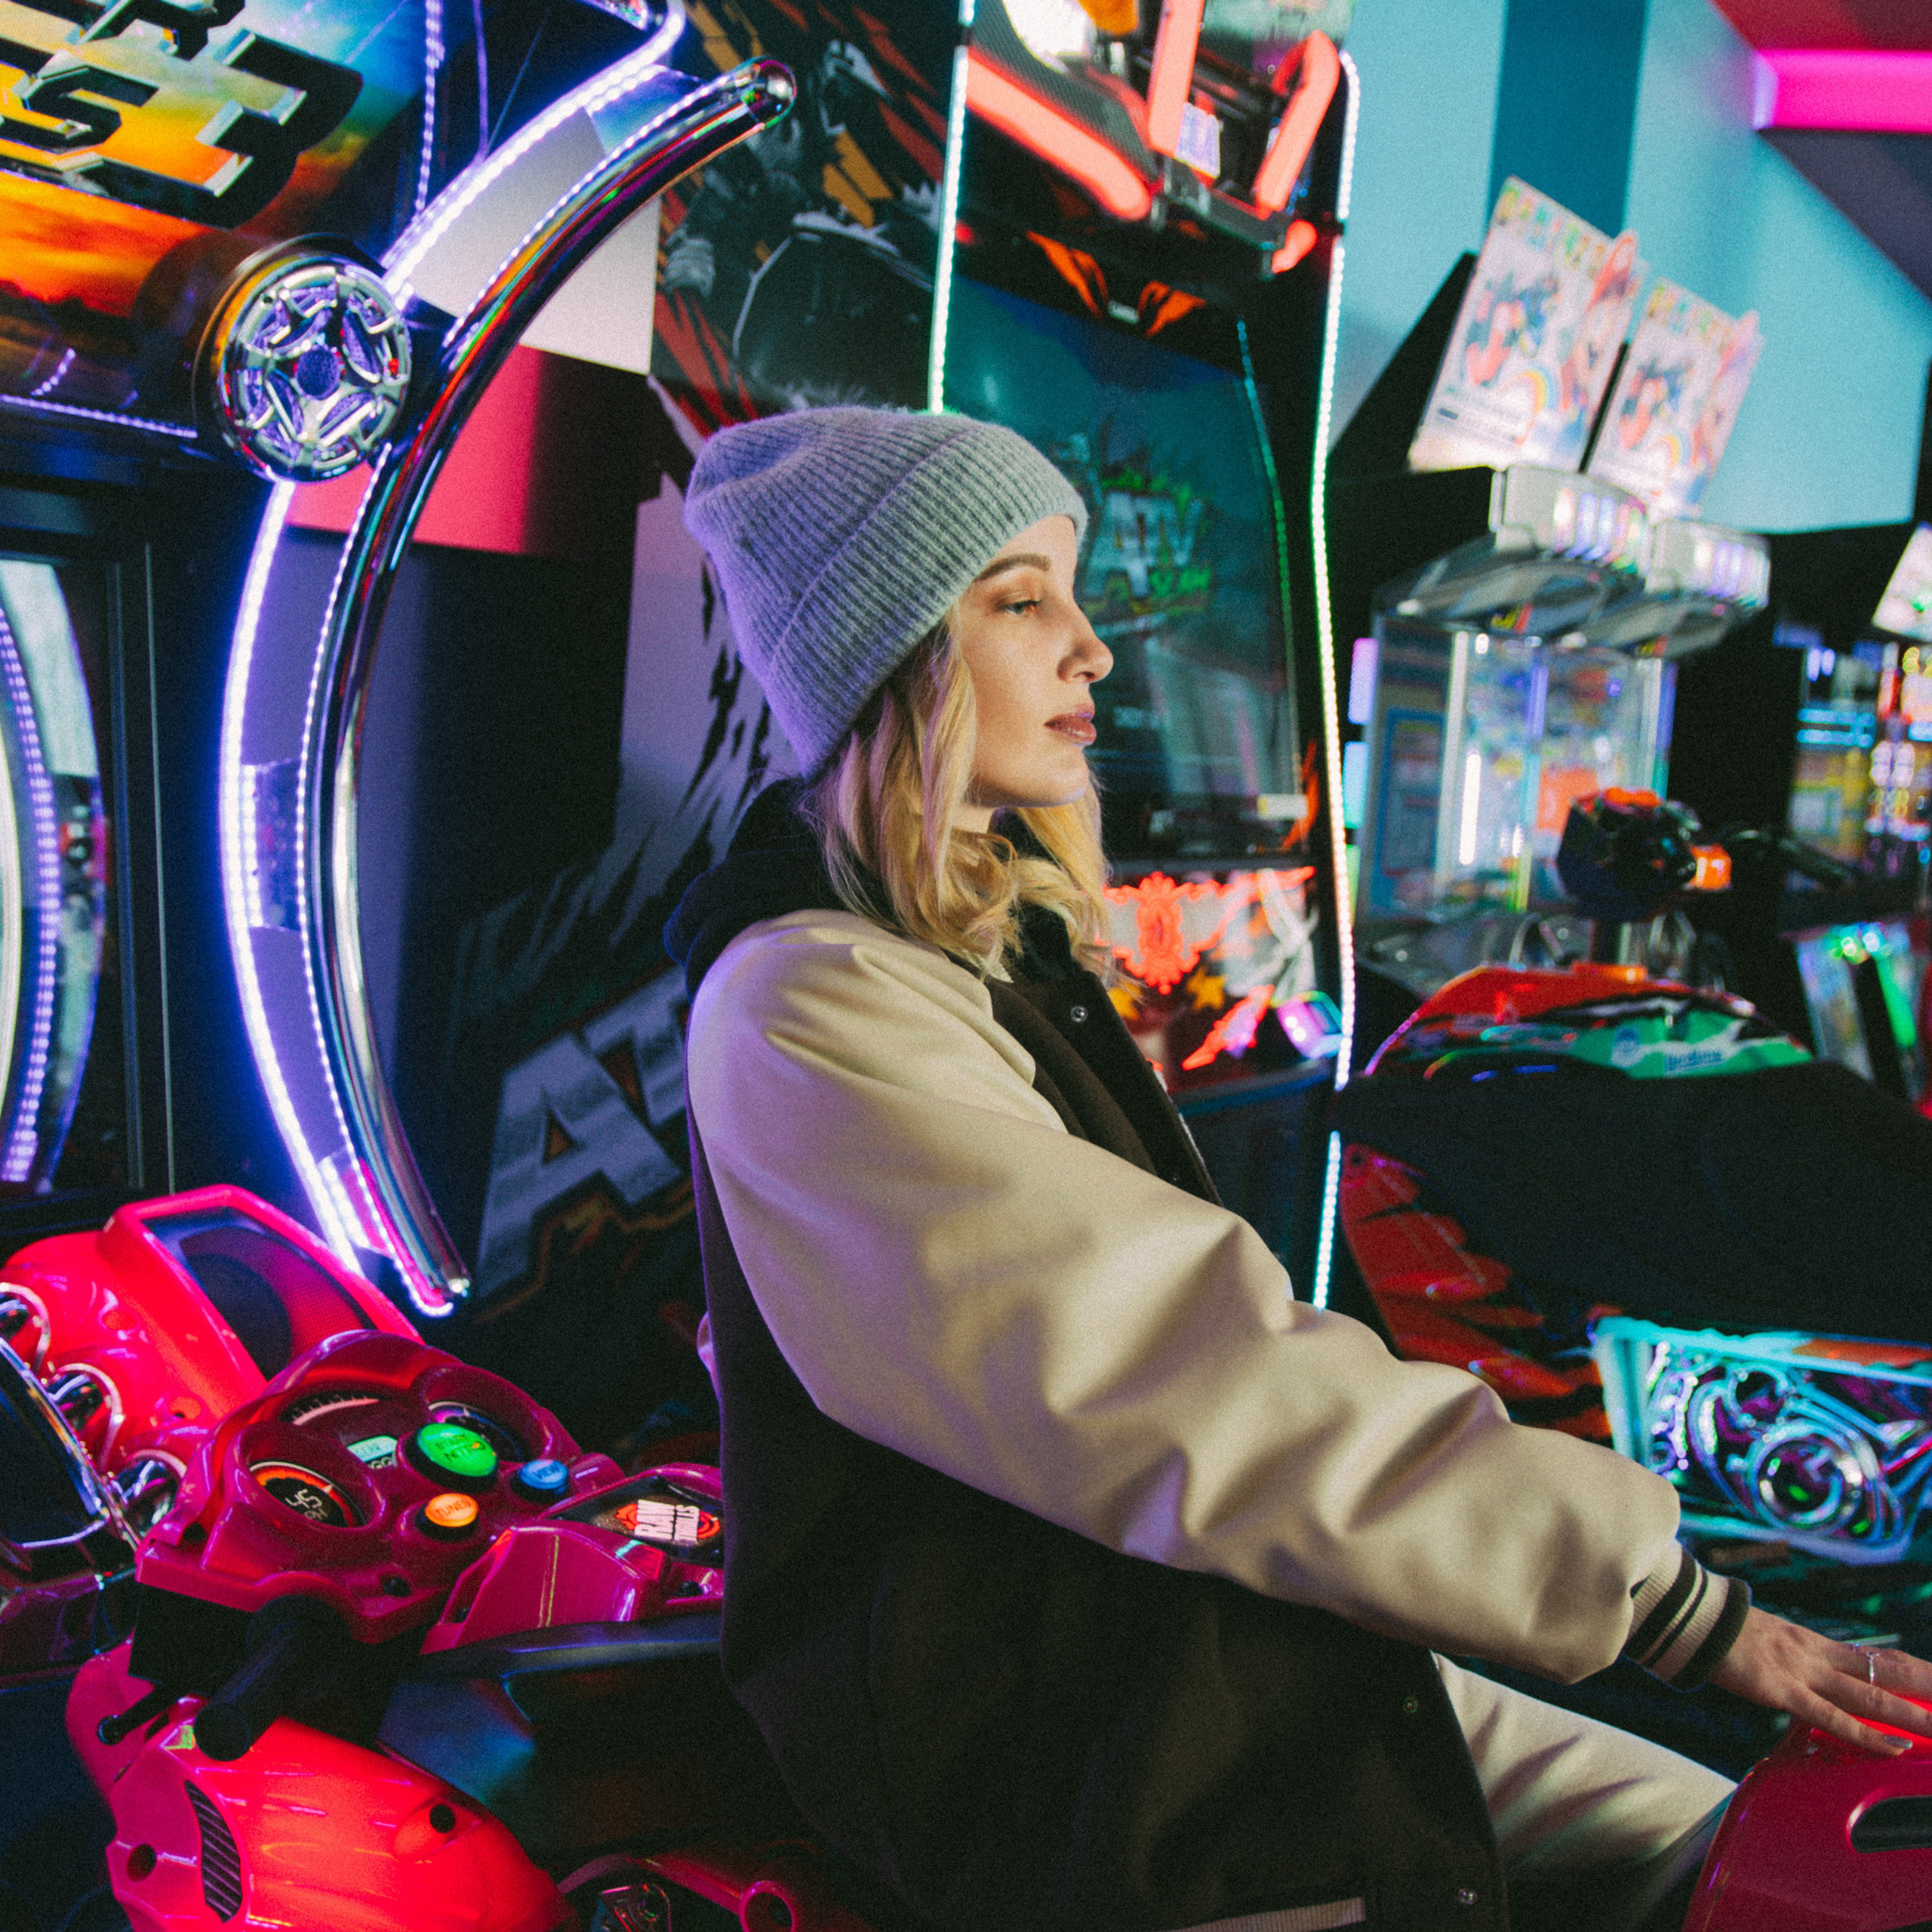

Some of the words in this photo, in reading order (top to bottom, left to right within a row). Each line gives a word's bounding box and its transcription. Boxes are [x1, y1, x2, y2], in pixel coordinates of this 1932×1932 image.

[477, 967, 688, 1298] AT
[532, 1463, 560, 1480] VIEW
[285, 1488, 323, 1509] 45
[635, 1500, 675, 1540] RAW
